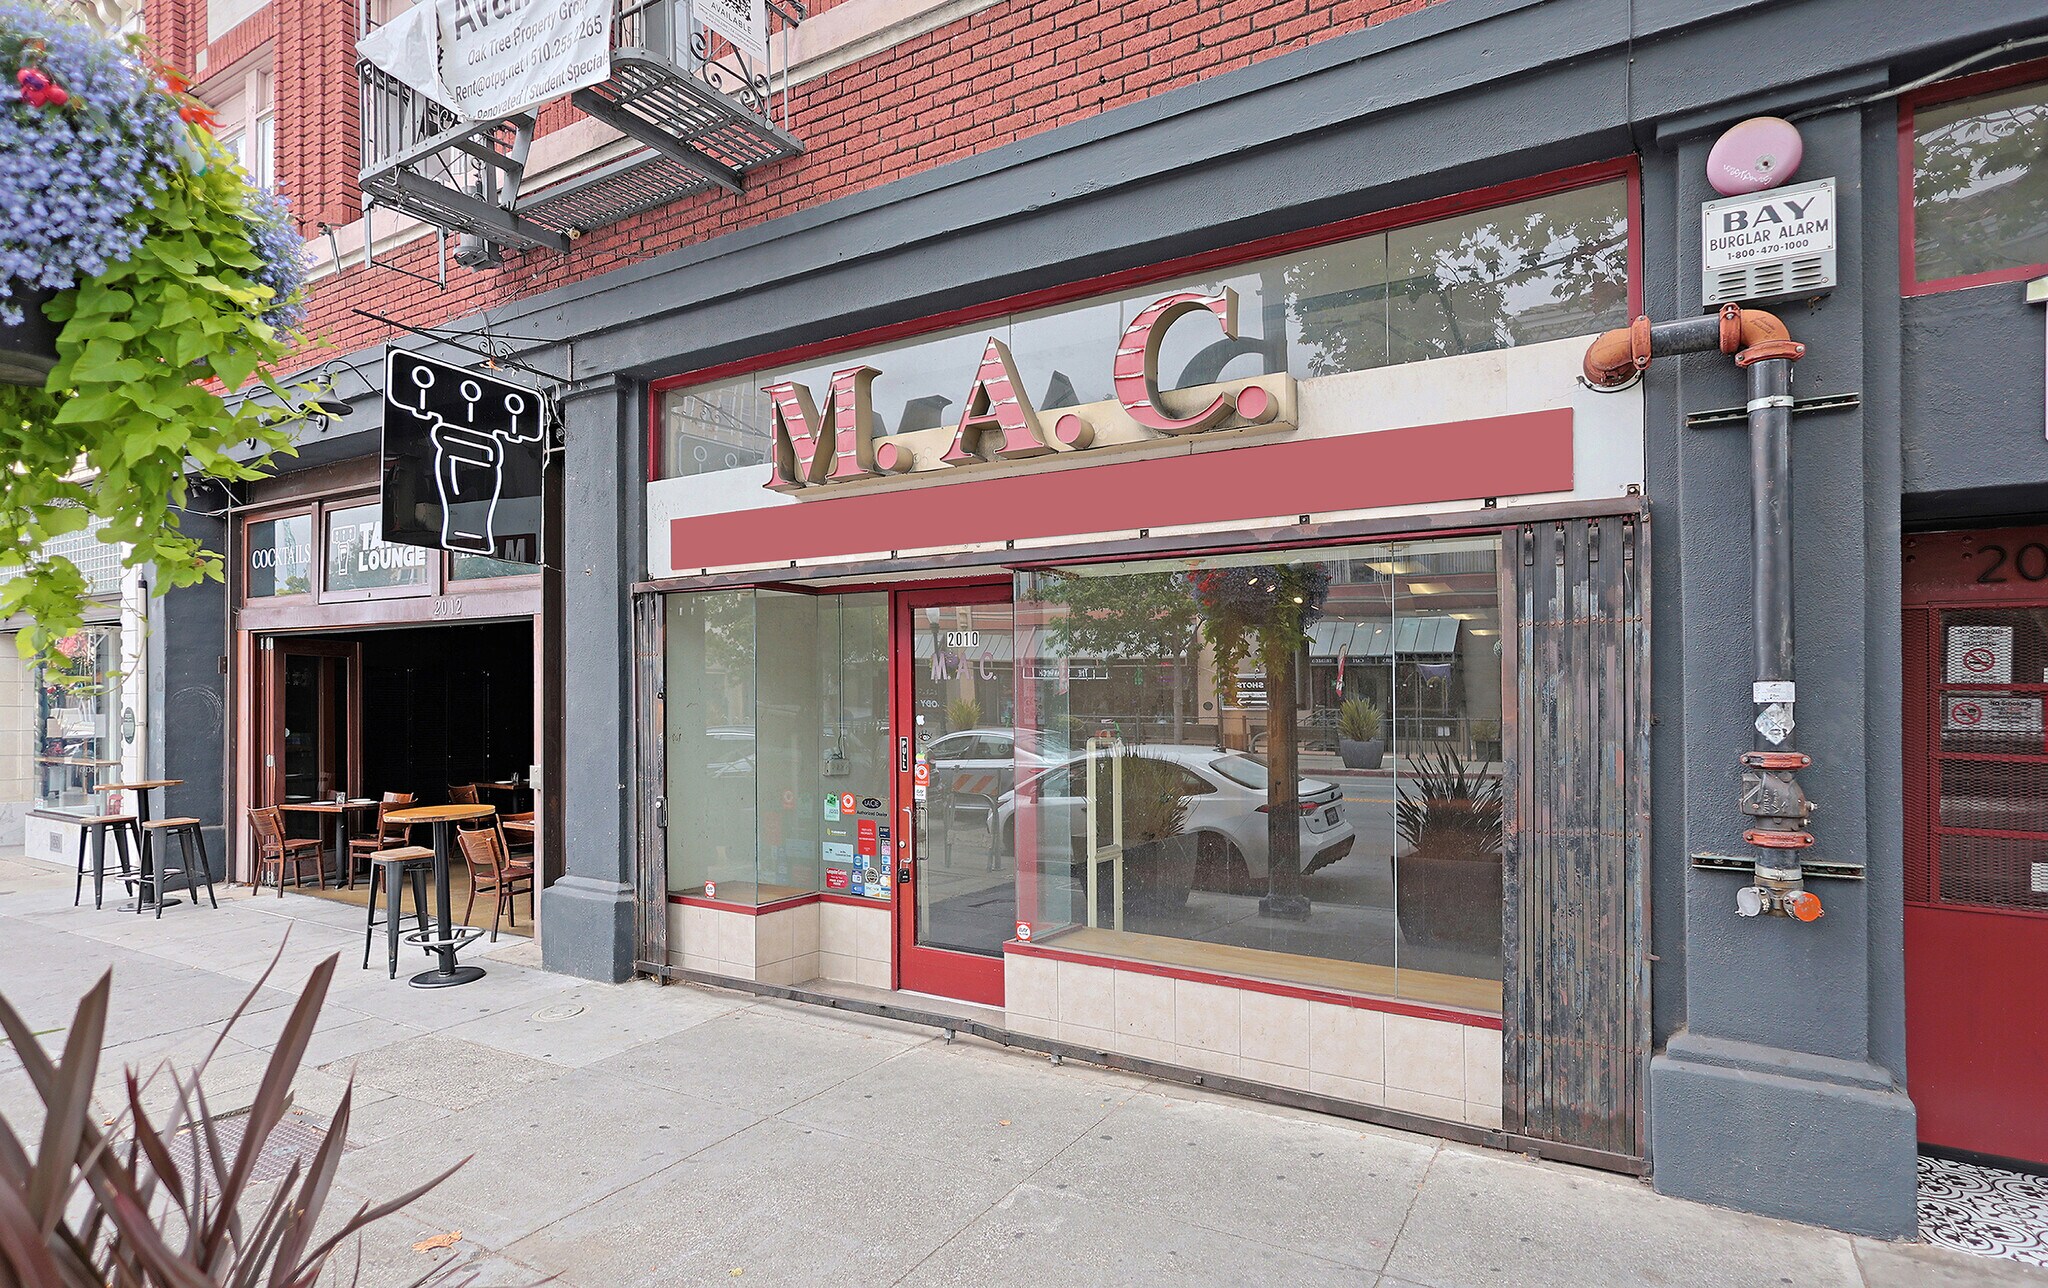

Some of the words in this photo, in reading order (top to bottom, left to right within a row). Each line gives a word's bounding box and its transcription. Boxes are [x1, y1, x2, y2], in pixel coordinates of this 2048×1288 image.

[710, 2, 752, 35] AVAILABLE
[468, 43, 486, 66] Oak
[489, 36, 512, 58] Tree
[513, 11, 556, 46] Property
[455, 58, 525, 102] Rent@otpg.net
[529, 71, 566, 99] Student
[567, 49, 609, 83] Specials
[1723, 196, 1815, 233] BAY
[1710, 229, 1771, 251] BURGLAR
[1779, 218, 1829, 239] ALARM
[1727, 239, 1809, 260] 1-800-470-1000
[359, 520, 392, 551] TA
[252, 543, 311, 569] COCKTAILS
[358, 544, 426, 572] LOUNGE
[1977, 542, 2048, 583] 20
[434, 599, 462, 616] 2012
[947, 632, 979, 646] 2010
